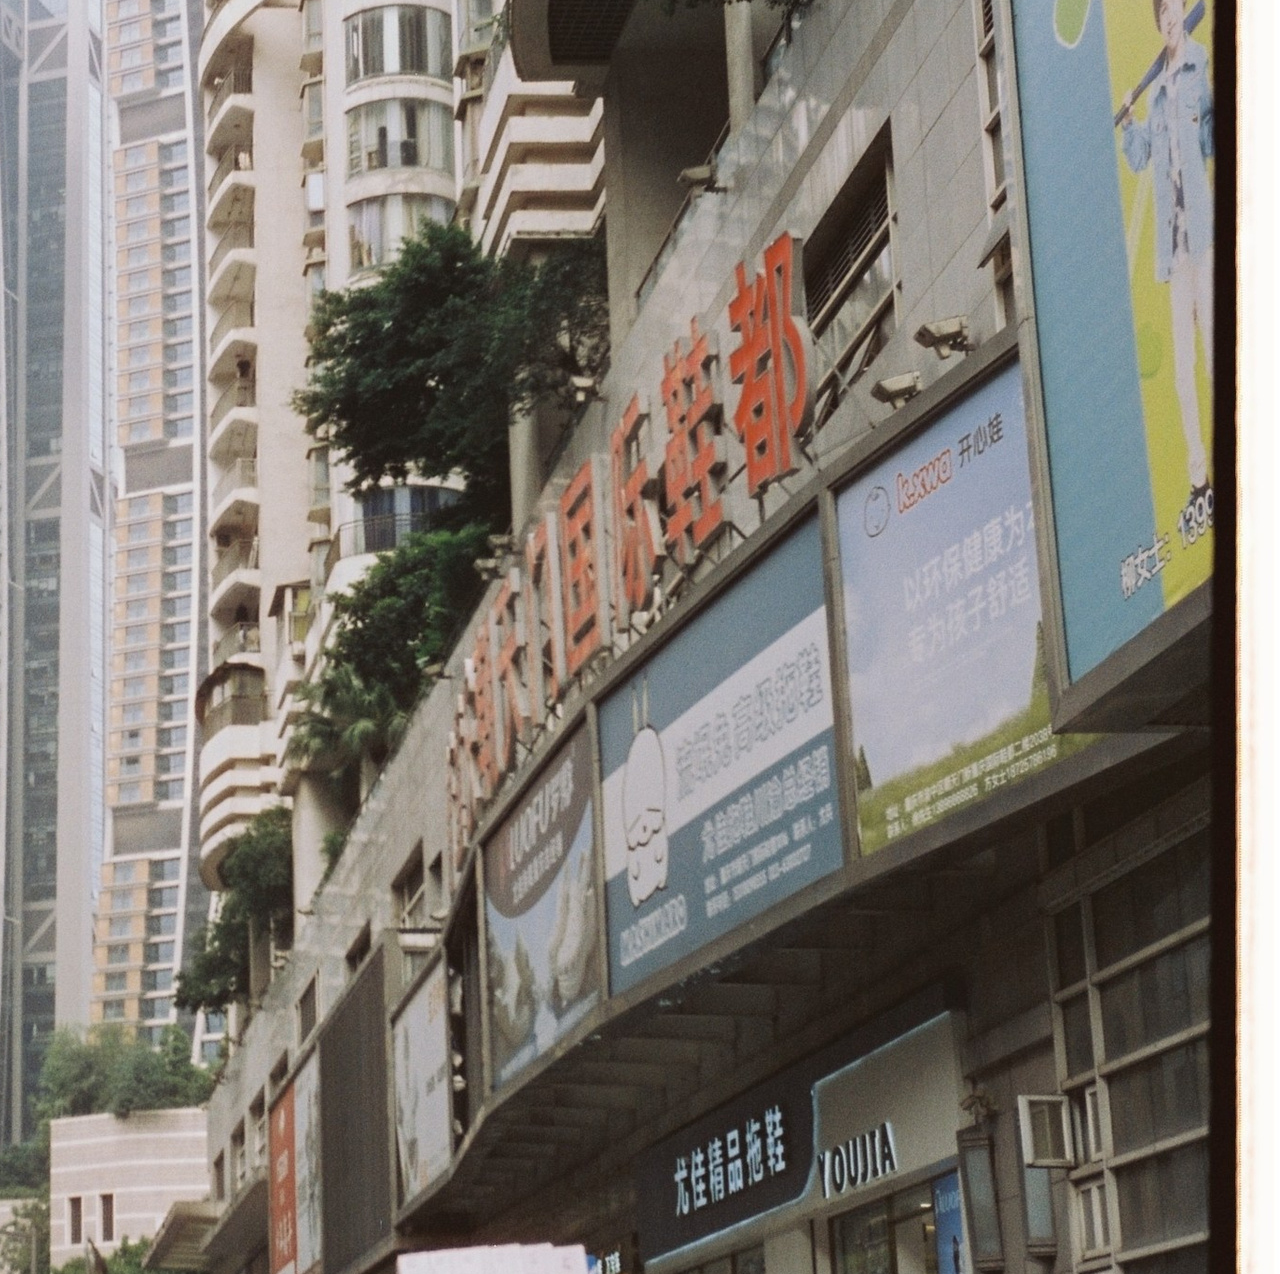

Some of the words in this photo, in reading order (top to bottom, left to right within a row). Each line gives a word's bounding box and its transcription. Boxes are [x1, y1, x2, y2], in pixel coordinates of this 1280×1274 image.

[958, 412, 1004, 468] 开心娃
[674, 1105, 785, 1217] 尤佳精品拖鞋
[819, 1118, 898, 1200] YOUJIA
